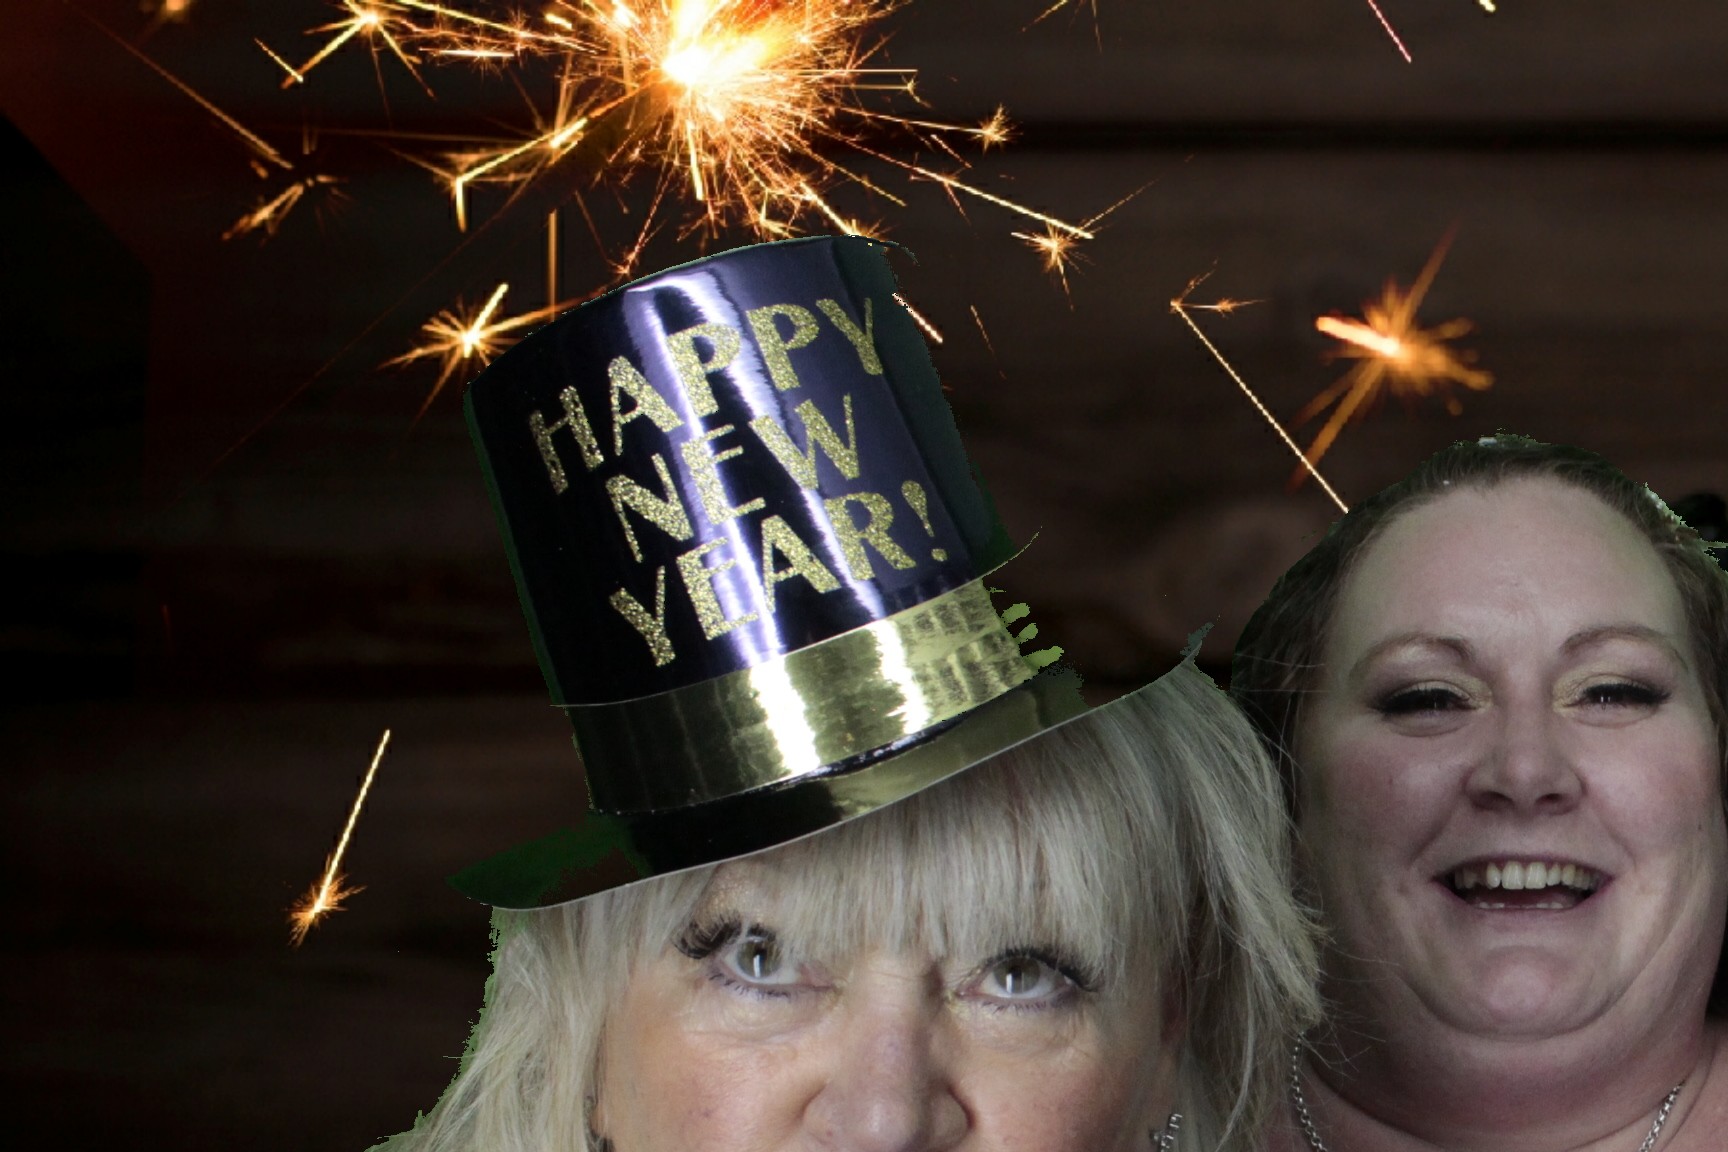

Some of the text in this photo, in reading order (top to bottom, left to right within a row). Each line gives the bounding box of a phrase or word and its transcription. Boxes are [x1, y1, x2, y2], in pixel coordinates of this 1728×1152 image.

[529, 298, 884, 495] HAPPY
[604, 394, 860, 563] NEW
[608, 479, 948, 668] YEAR!
